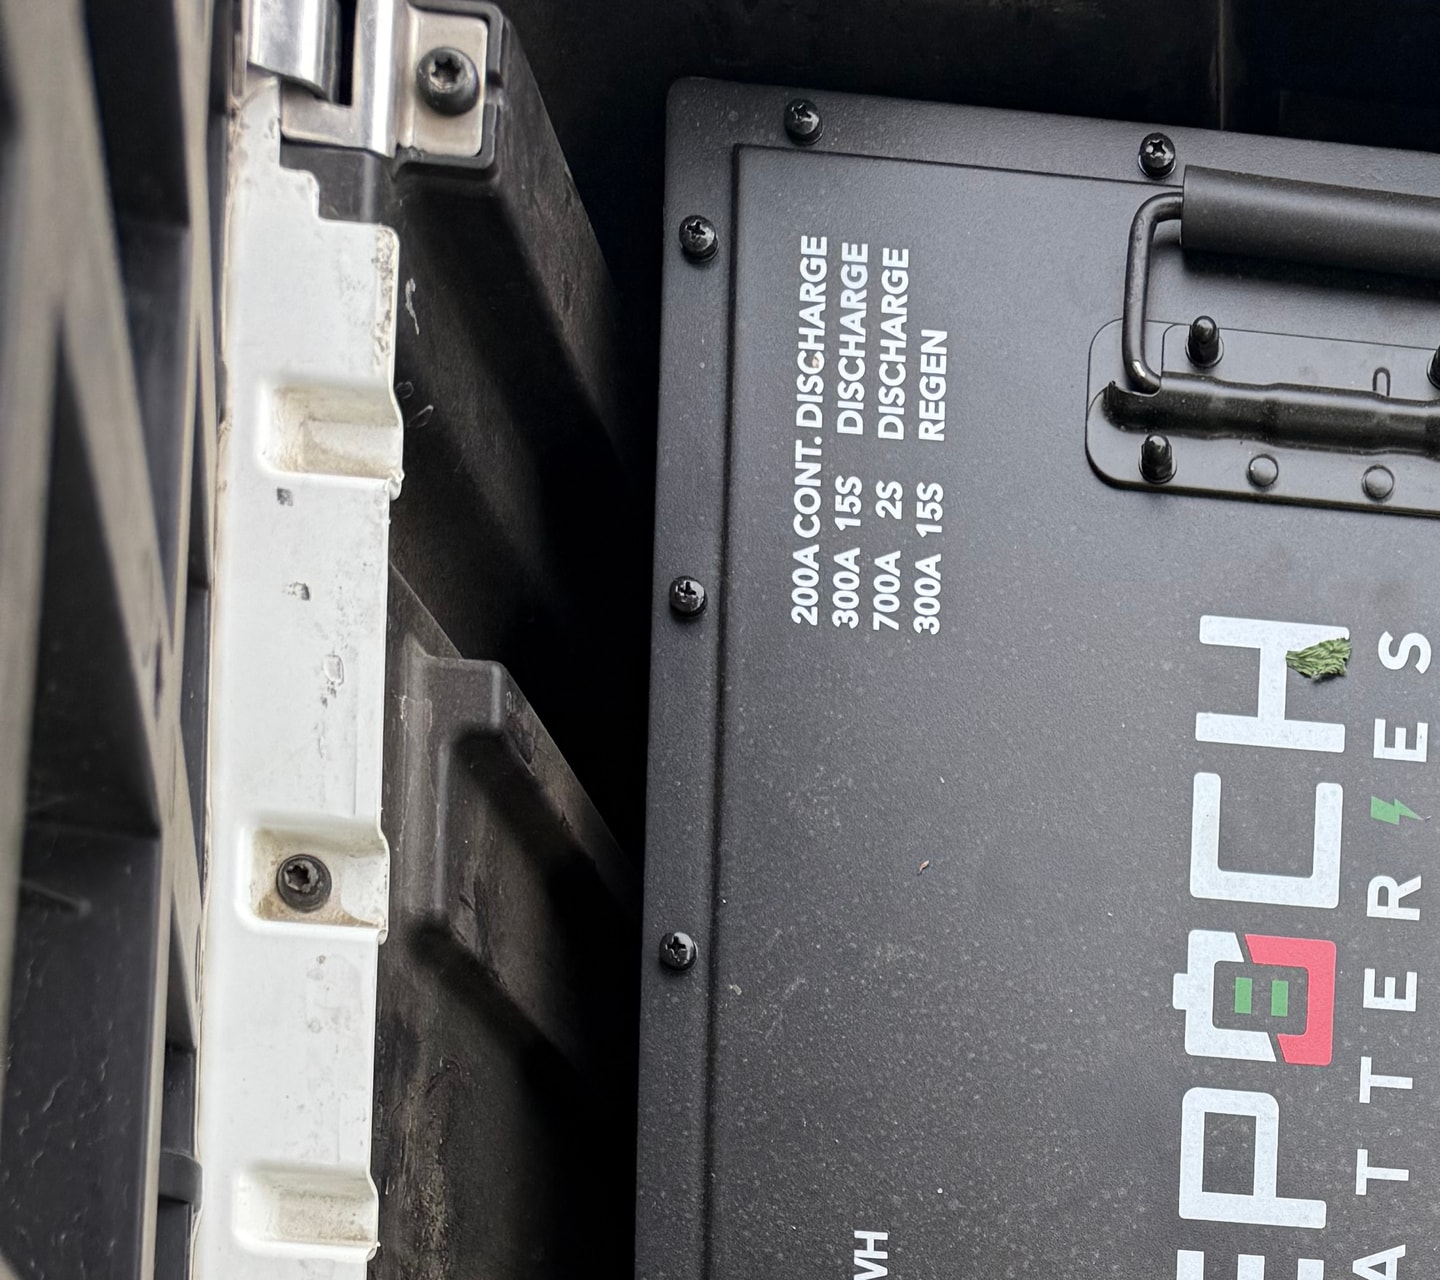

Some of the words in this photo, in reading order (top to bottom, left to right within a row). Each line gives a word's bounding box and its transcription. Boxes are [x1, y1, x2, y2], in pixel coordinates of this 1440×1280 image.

[796, 236, 827, 428] DISCHARGE
[837, 242, 868, 435] DISCHARGE
[878, 248, 909, 440] DISCHARGE
[919, 329, 947, 441] REGEN
[793, 436, 822, 538] CONT.
[835, 475, 862, 531] 15S
[876, 480, 903, 519] 2S
[916, 482, 944, 537] 15S
[792, 544, 819, 626] 200A
[832, 548, 860, 629] 300A
[873, 550, 901, 631] 700A
[913, 554, 941, 635] 300A
